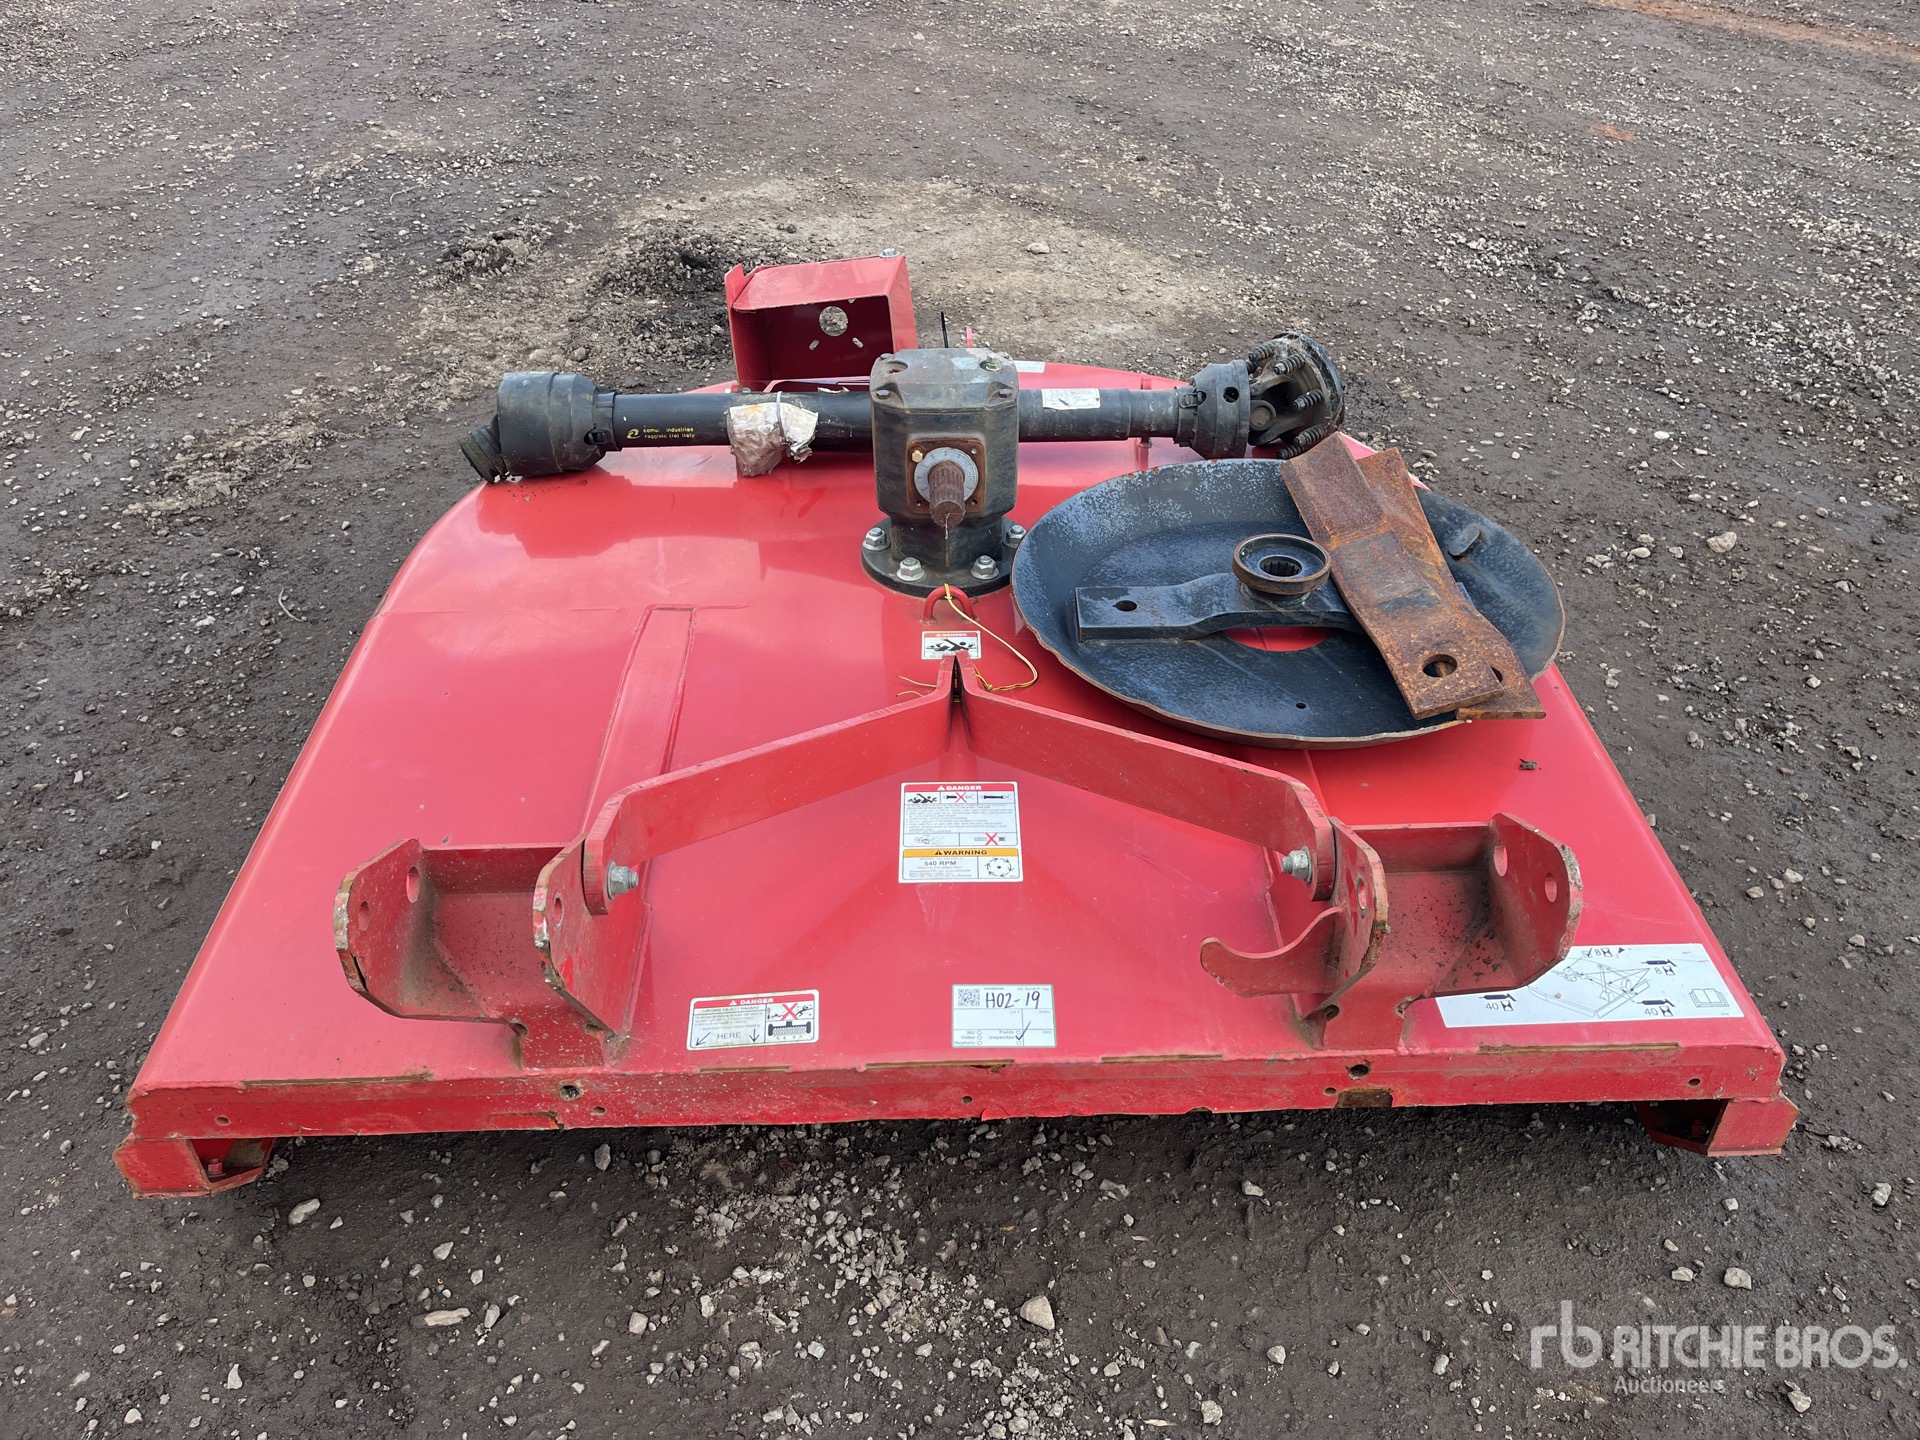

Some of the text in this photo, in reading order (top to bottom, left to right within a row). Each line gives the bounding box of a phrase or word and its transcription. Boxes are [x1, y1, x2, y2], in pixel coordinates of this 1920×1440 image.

[1594, 948, 1602, 956] 8
[1654, 967, 1662, 975] 8
[1485, 1001, 1499, 1011] 40
[1644, 1007, 1659, 1016] 40
